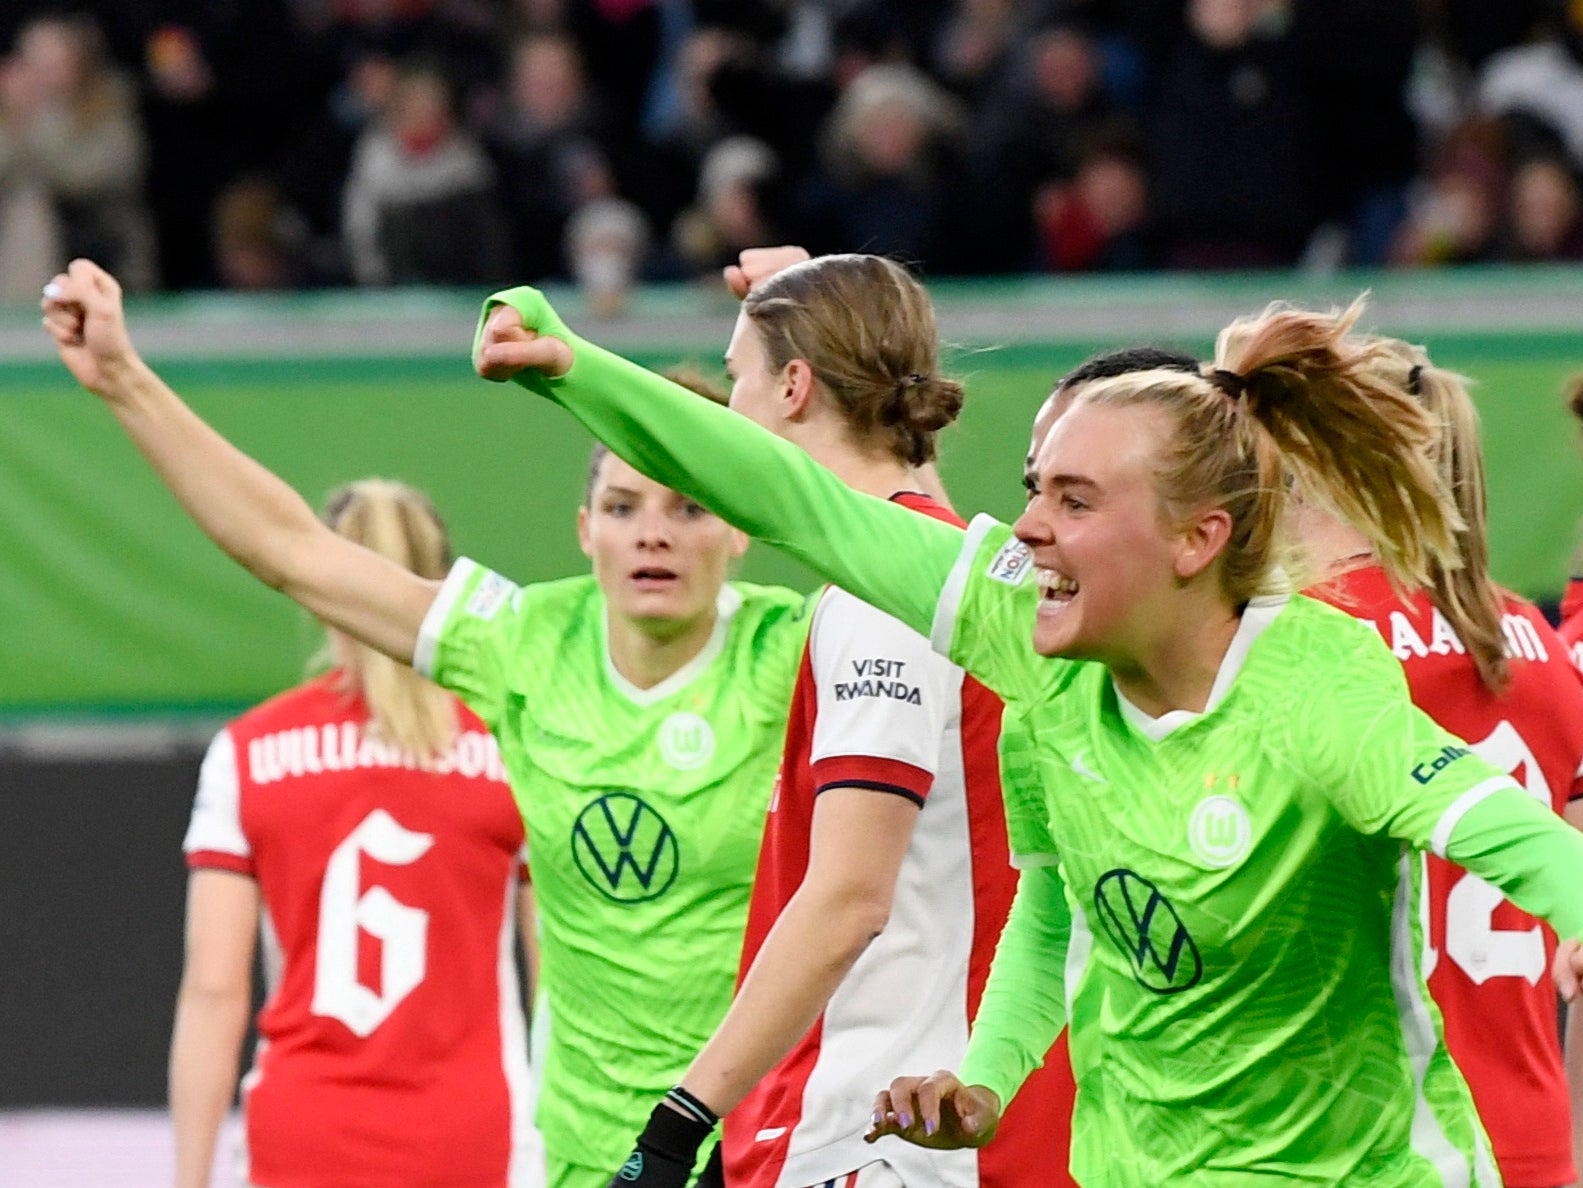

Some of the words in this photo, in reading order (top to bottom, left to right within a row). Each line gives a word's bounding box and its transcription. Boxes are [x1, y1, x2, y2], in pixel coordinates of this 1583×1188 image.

[852, 658, 906, 679] VISIT
[834, 679, 922, 706] RWANDA
[310, 807, 436, 1038] 6
